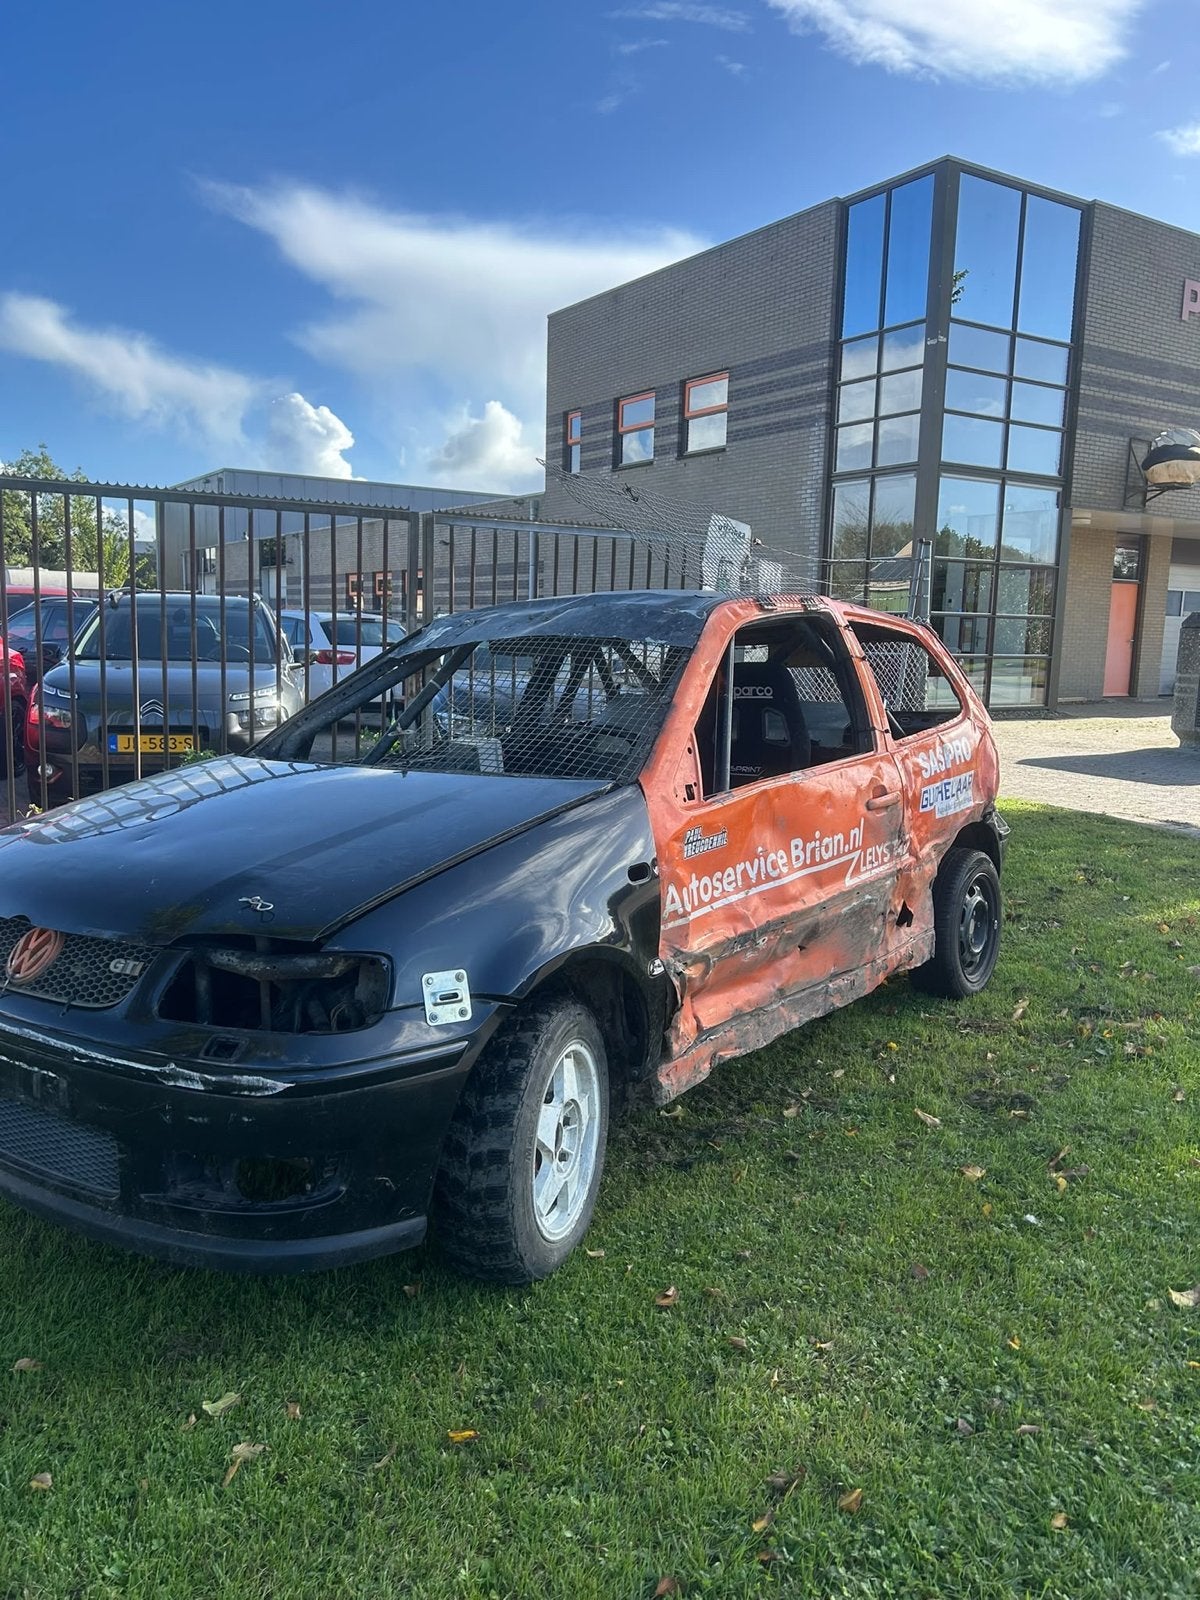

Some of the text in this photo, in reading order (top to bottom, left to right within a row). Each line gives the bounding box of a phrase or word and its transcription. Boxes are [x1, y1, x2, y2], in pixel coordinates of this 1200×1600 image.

[734, 685, 773, 699] parco
[123, 737, 192, 750] J-583-S
[919, 737, 972, 778] SASPRO
